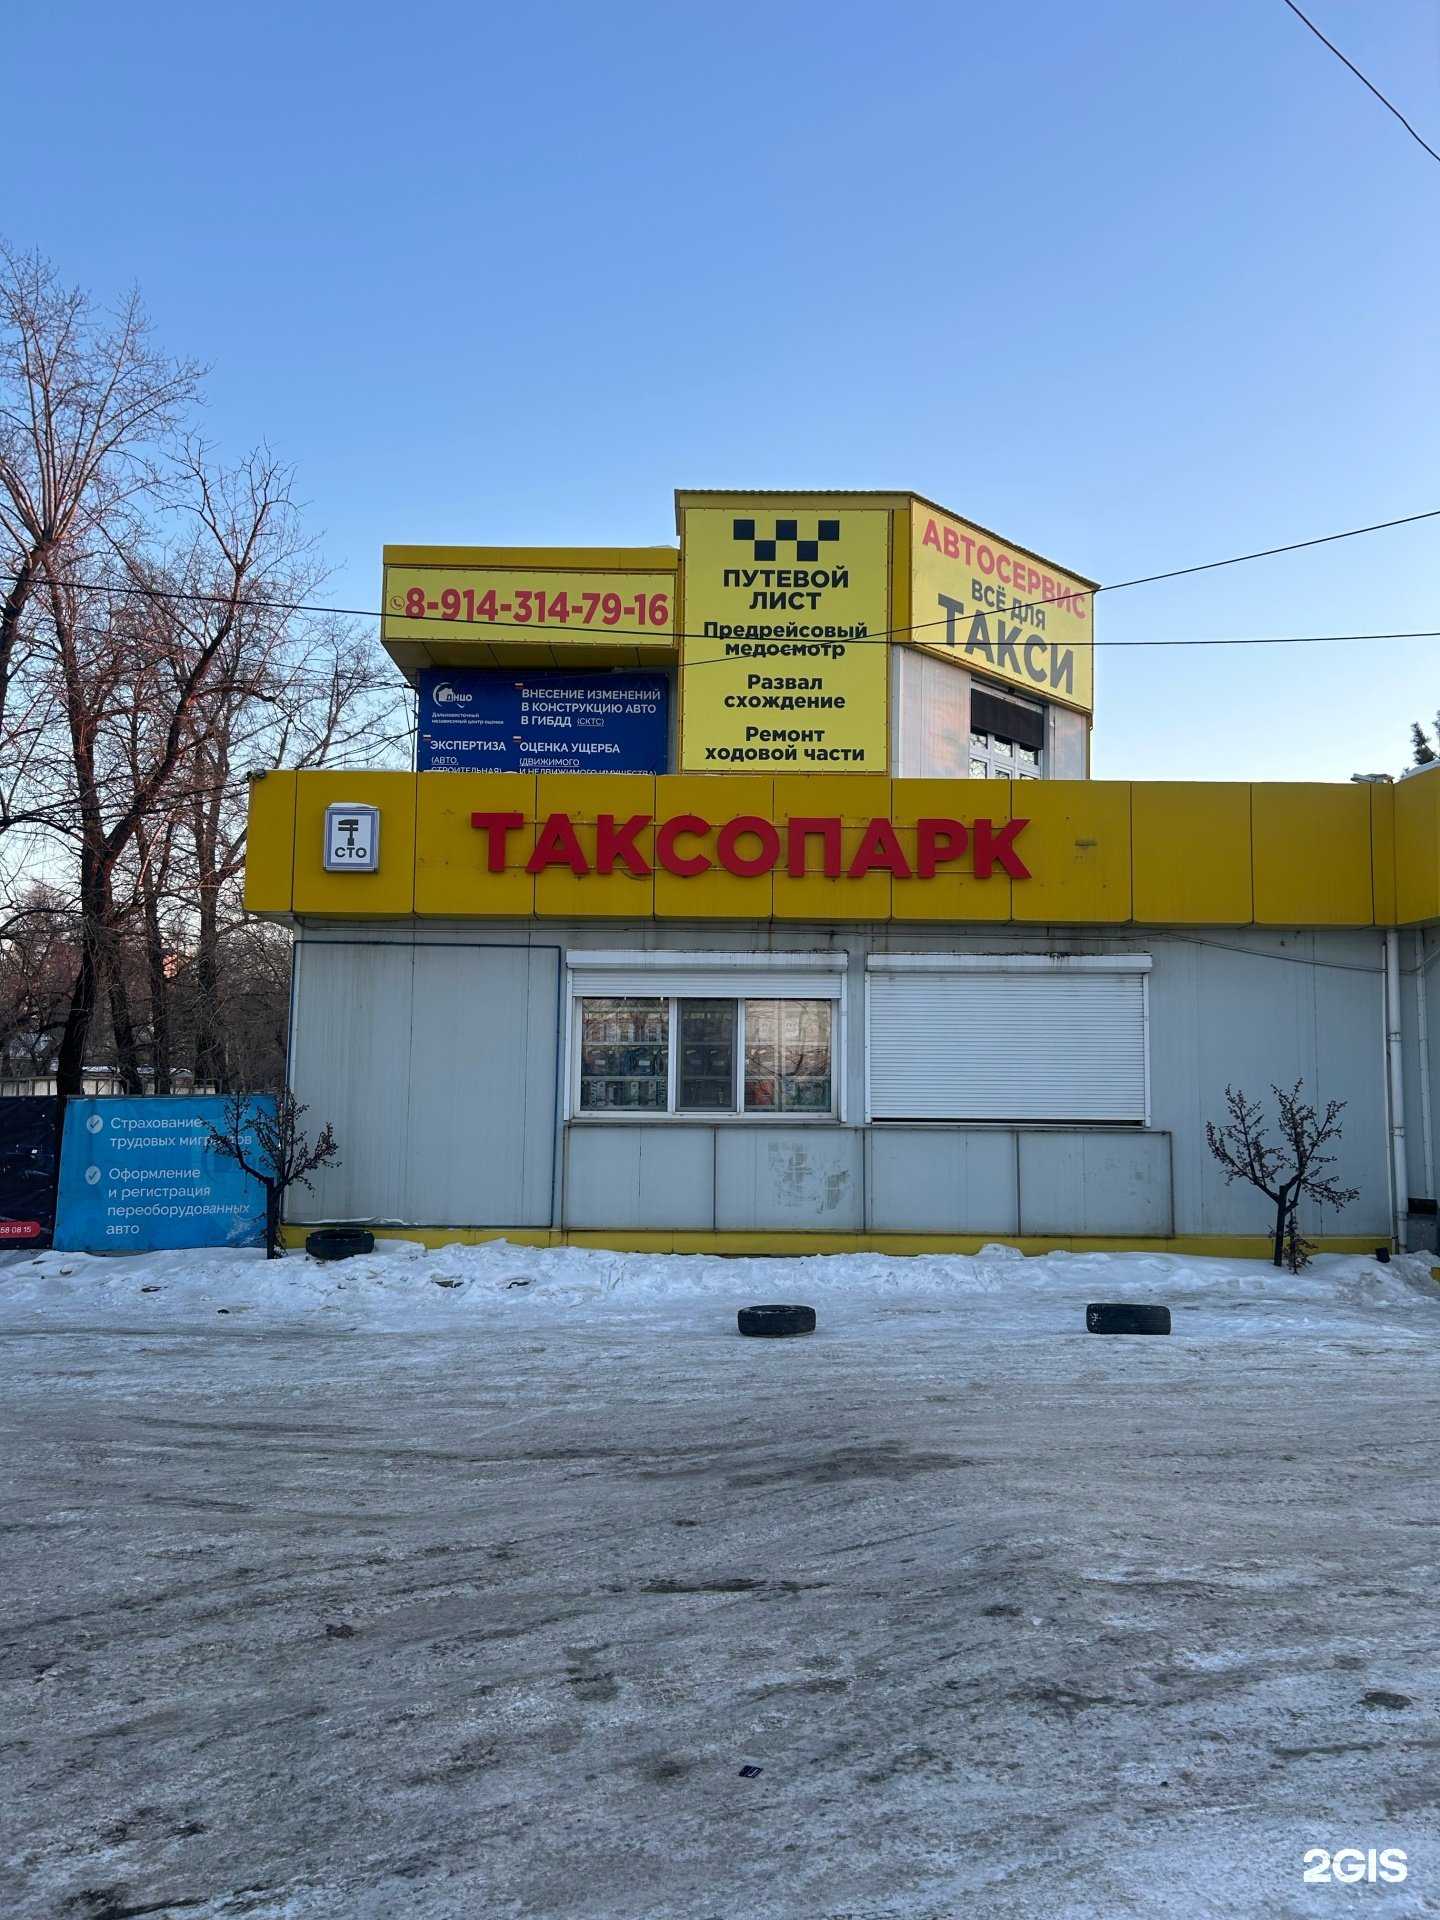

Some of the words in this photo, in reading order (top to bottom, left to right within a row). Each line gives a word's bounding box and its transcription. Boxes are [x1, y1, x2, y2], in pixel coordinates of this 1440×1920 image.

[923, 518, 1088, 619] АВТОСЕРВИС
[724, 566, 848, 588] ПУТЕВОЙ
[405, 587, 669, 626] 8-914-314-79-16
[750, 592, 821, 610] ЛИСТ
[972, 578, 1006, 611] ВСЁ
[1011, 599, 1045, 630] ДЛЯ
[704, 621, 867, 640] Предрейсовый
[725, 642, 845, 659] медосмотр
[938, 593, 1073, 694] ТАКСИ
[748, 674, 822, 690] Развал
[522, 688, 584, 700] ВНЕСЕНИЕ
[587, 687, 661, 701] ИЗМЕНЕНИЙ
[522, 703, 529, 713] В
[532, 703, 623, 714] КОНСТРУКЦИЮ
[626, 704, 657, 714] АВТО
[725, 695, 845, 711] схождение
[521, 716, 528, 726] В
[531, 716, 572, 728] ГИБДД
[746, 727, 824, 743] Ремонт
[430, 740, 506, 752] ЭКСПЕРТИЗА
[520, 742, 569, 755] ОЦЕНКА
[571, 743, 620, 756] УЩЕРБА
[706, 745, 797, 763] ходовой
[804, 747, 865, 762] части
[334, 846, 367, 859] СТО
[471, 813, 1032, 879] ТАКСОПАРК
[110, 1117, 202, 1131] Страхование
[110, 1136, 176, 1150] трудовых
[109, 1167, 201, 1181] Оформление
[108, 1189, 117, 1198] и
[121, 1186, 210, 1200] регистрация
[107, 1203, 249, 1217] переоборудованных
[106, 1223, 140, 1235] авто
